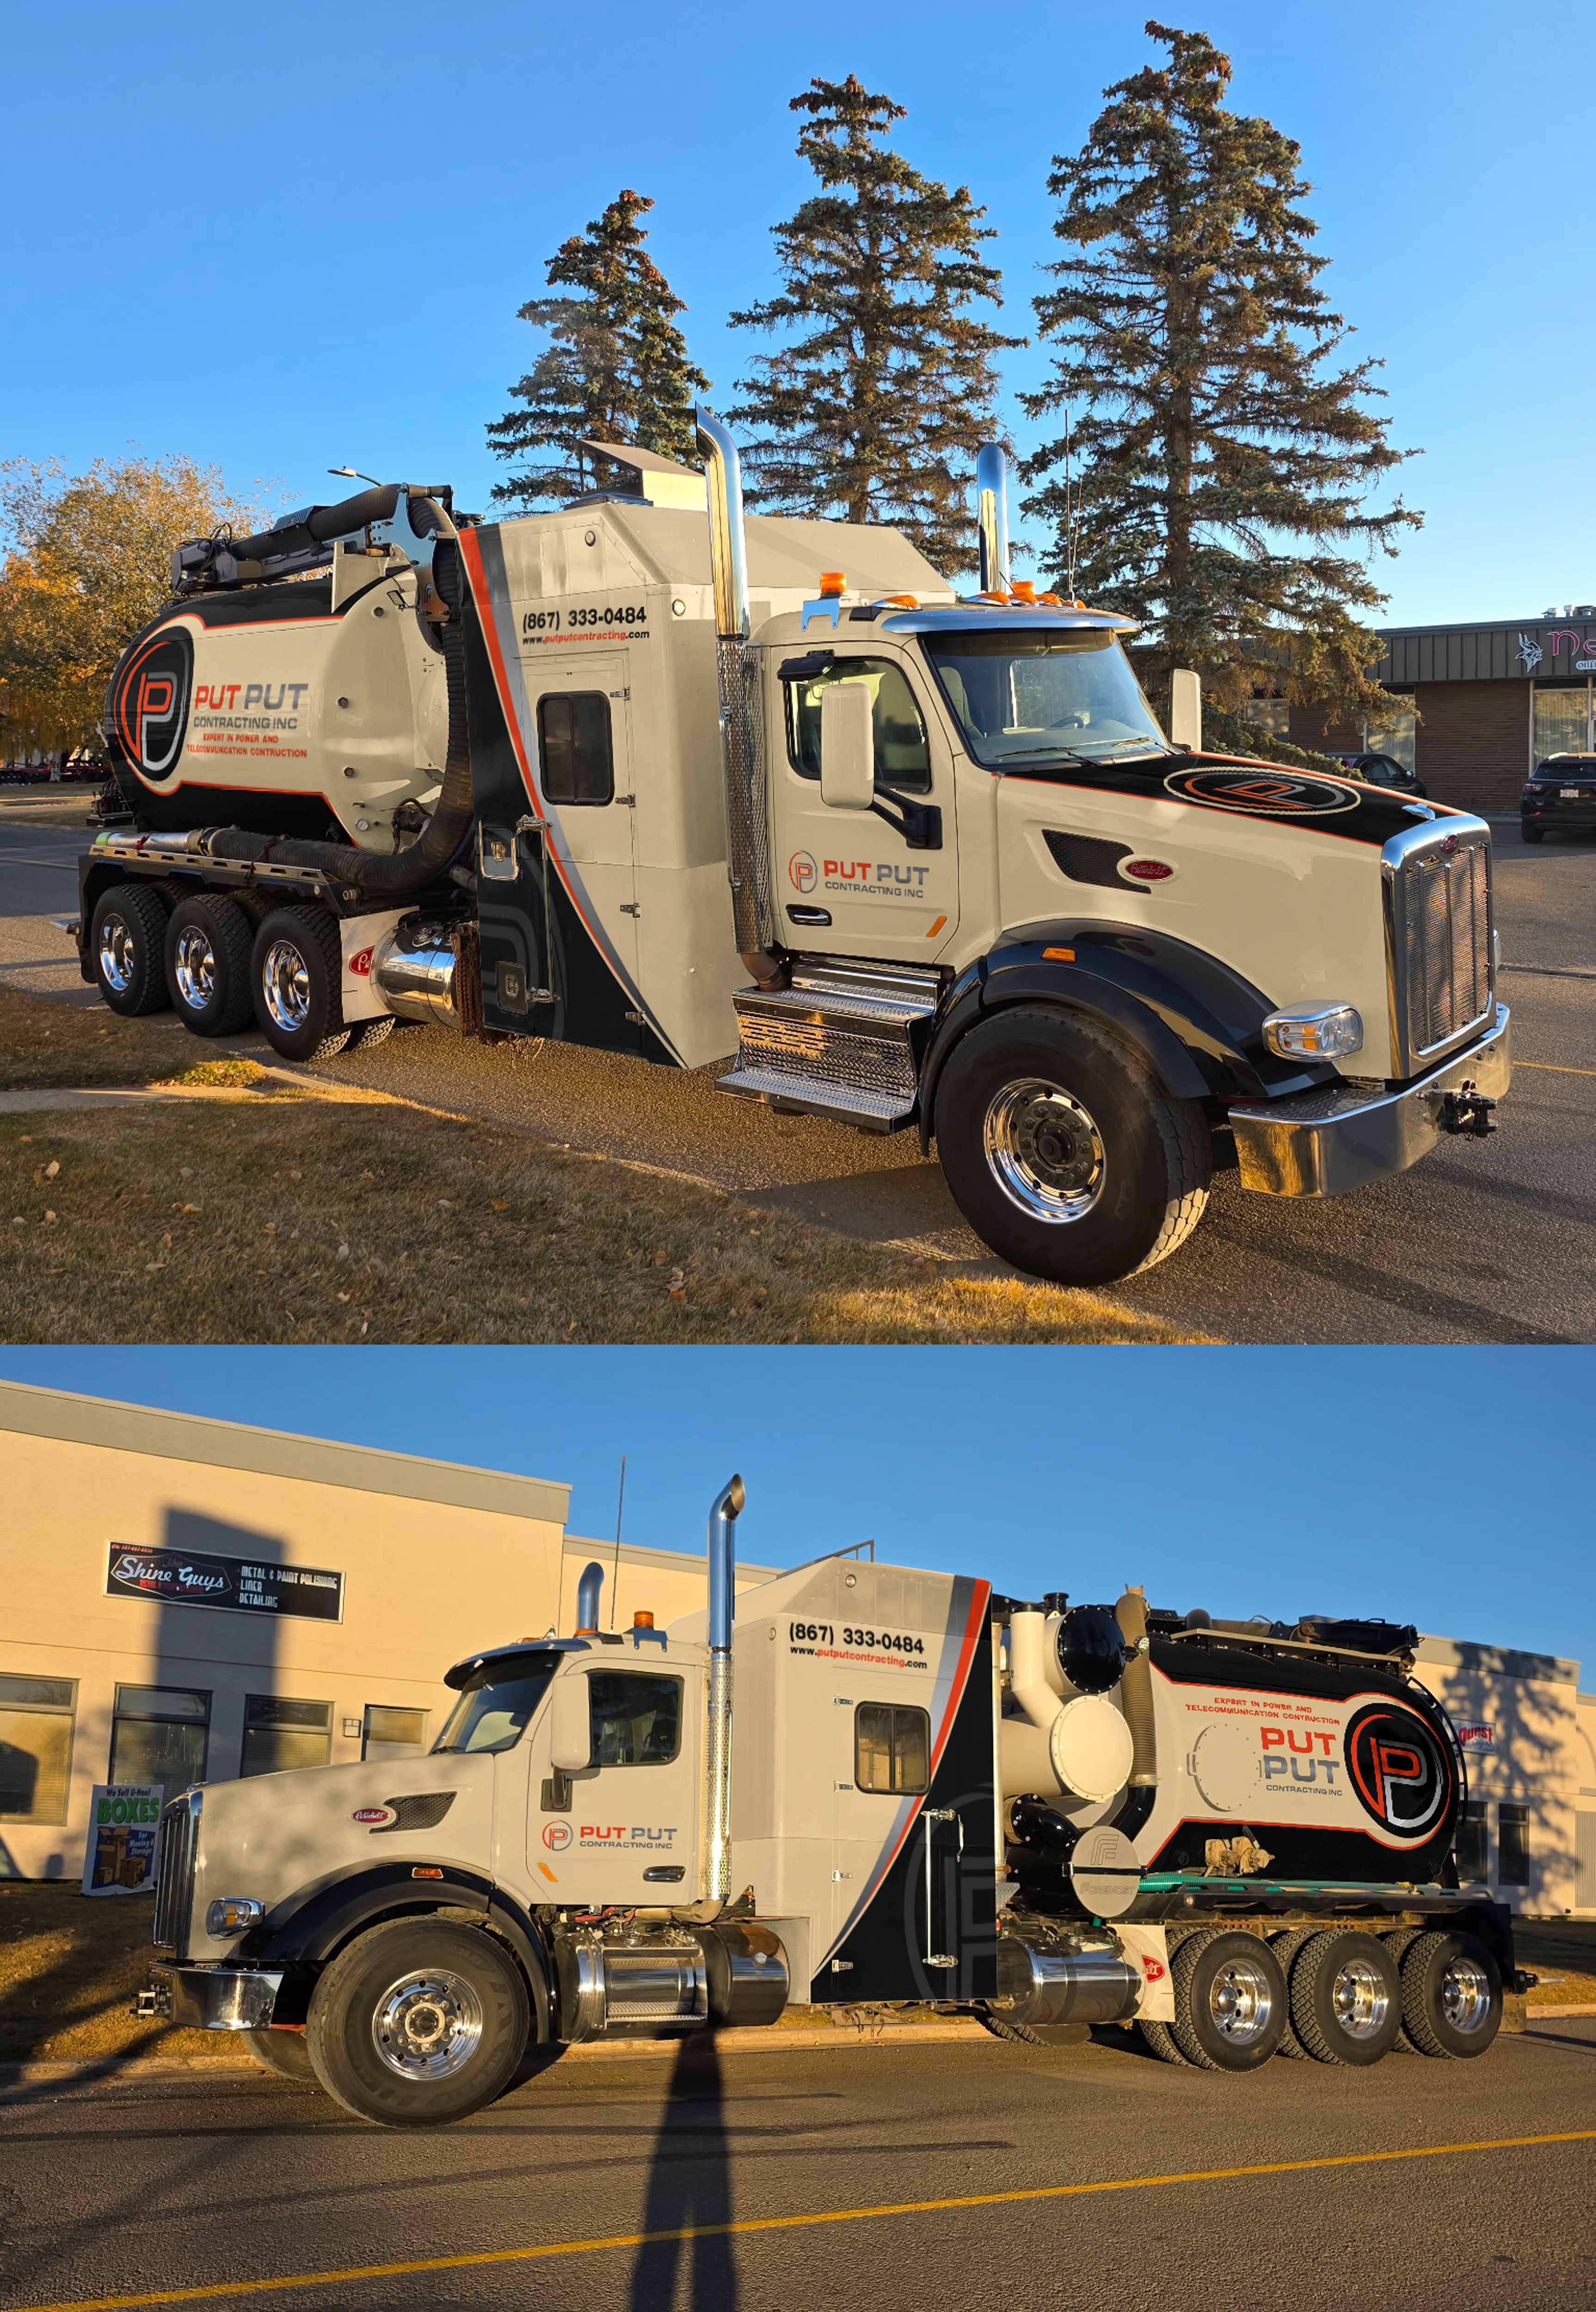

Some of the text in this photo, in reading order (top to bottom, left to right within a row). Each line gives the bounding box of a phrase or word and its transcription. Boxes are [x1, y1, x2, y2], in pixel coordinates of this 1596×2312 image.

[523, 606, 647, 633] (867) 333-0484
[522, 629, 650, 645] www.putputcontracting.com
[195, 683, 309, 710] PUT PUT
[194, 717, 298, 729] CONTRACTING INC
[203, 733, 225, 742] EXPERT
[236, 734, 259, 743] POWER
[262, 735, 279, 744] AND
[250, 747, 307, 758] CONTRUCTION
[823, 860, 929, 885] PUT PUT
[1131, 863, 1167, 875] Peterbilt
[825, 881, 923, 898] CONTRACTING INC
[116, 1557, 172, 1581] Shine
[178, 1567, 224, 1591] Guys
[241, 1566, 266, 1579] METAL
[277, 1571, 299, 1584] PAINT
[300, 1574, 338, 1589] POLISHING
[240, 1580, 262, 1593] LINER
[239, 1593, 278, 1608] DETAILING
[790, 1622, 924, 1654] (867) 333-0484
[790, 1647, 927, 1669] www.putputcontracting.com
[1214, 1697, 1247, 1706] EXPERT
[1263, 1702, 1292, 1710] POWER
[1185, 1704, 1340, 1725] TELECOMMUNICATION CONTRUCTION
[1260, 1727, 1336, 1755] PUT
[1458, 1726, 1493, 1747] Quest
[1263, 1755, 1340, 1784] PUT
[1266, 1785, 1327, 1795] CONTRACTING
[97, 1797, 160, 1824] BOXES
[355, 1811, 386, 1820] Peterbilt
[580, 1826, 677, 1840] PUT PUT
[129, 1839, 150, 1848] Moving
[131, 1848, 153, 1856] Storage
